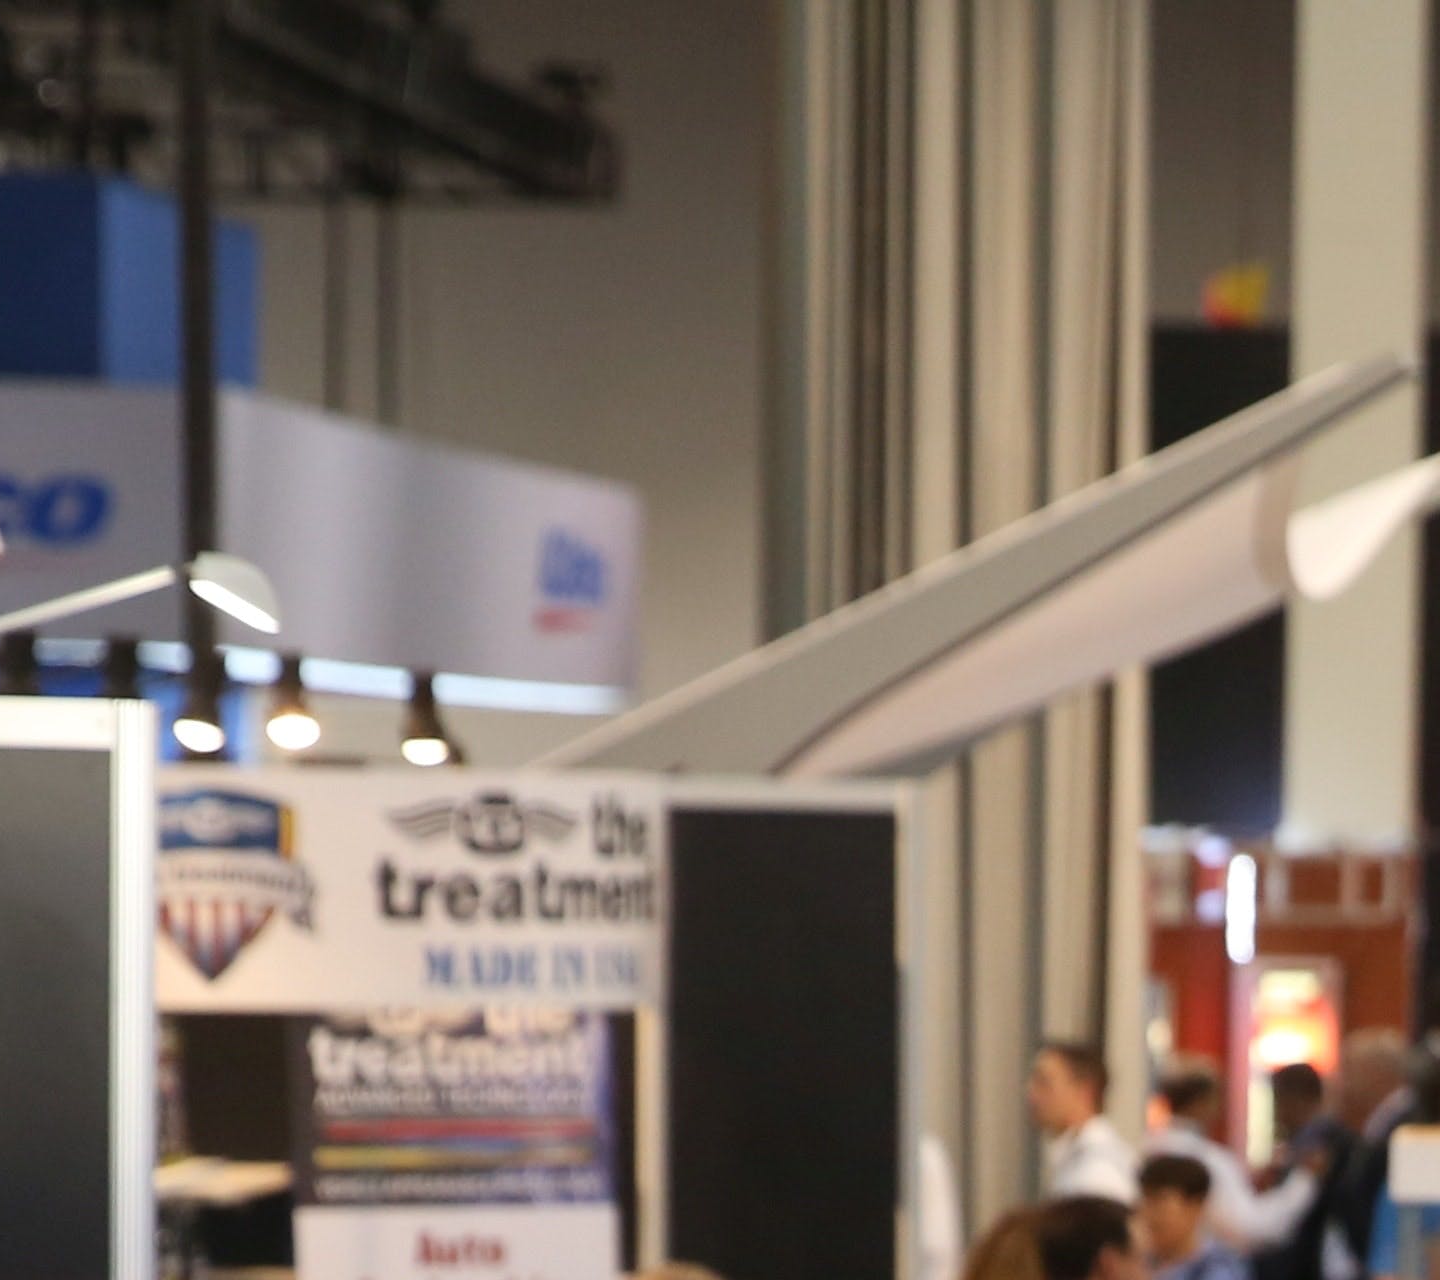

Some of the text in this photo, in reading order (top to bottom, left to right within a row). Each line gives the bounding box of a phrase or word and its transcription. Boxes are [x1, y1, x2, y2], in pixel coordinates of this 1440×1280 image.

[376, 862, 655, 922] treatment
[308, 1022, 592, 1084] treatment
[413, 1228, 508, 1272] Auto
